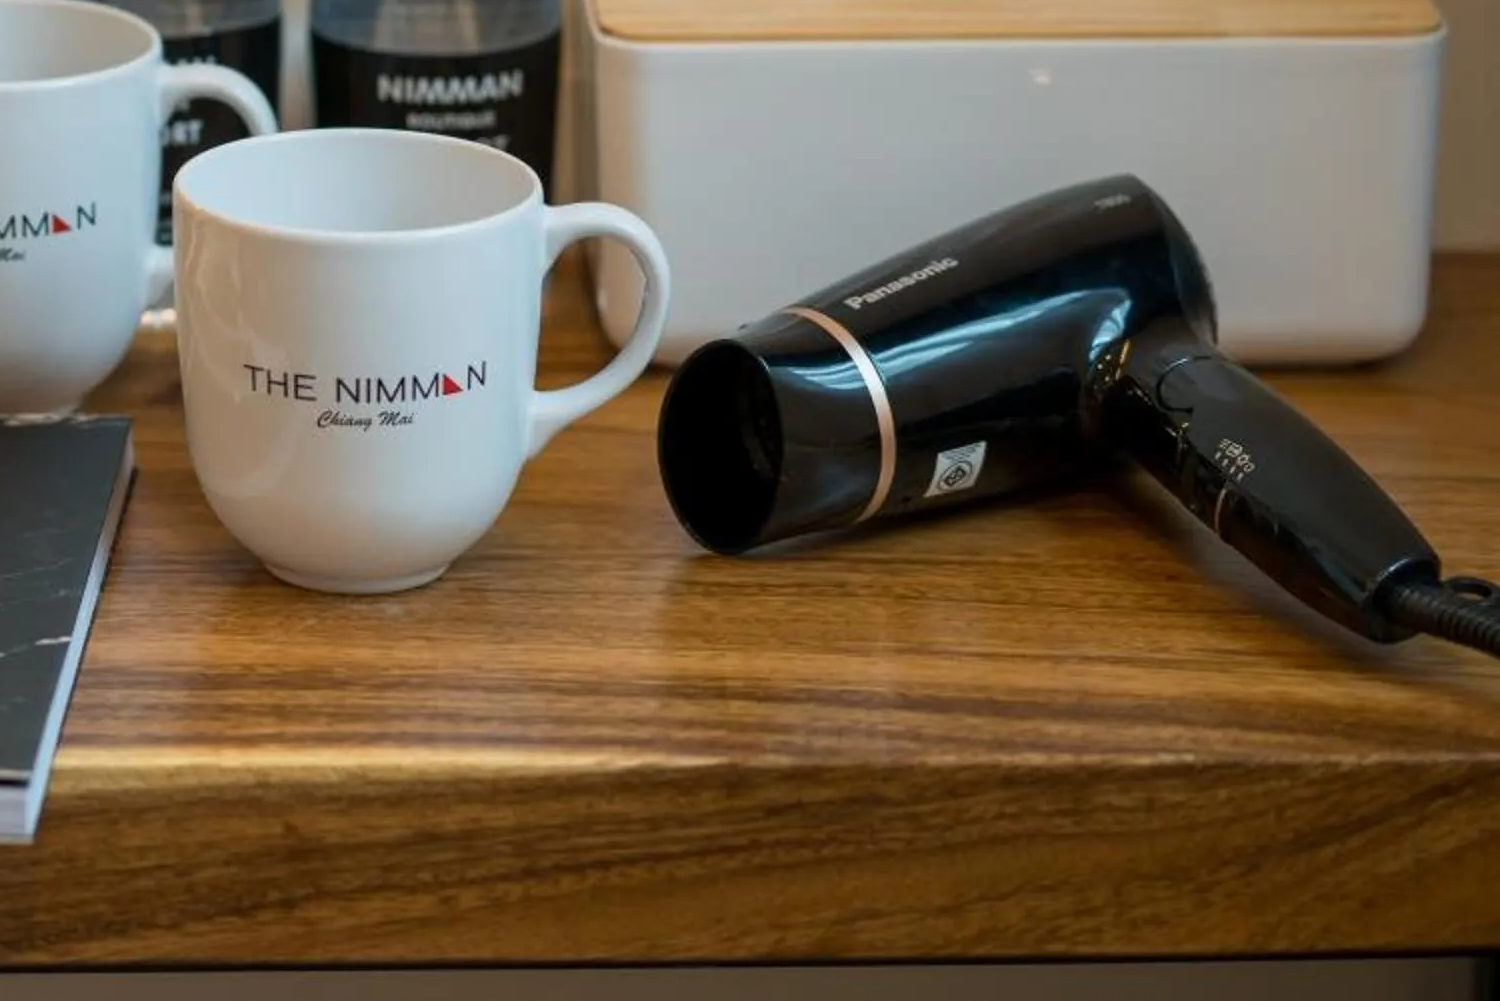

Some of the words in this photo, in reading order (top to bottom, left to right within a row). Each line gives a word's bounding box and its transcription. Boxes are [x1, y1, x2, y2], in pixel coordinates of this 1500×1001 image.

[376, 68, 525, 105] NIMMAN
[843, 257, 959, 311] Panasonic
[243, 363, 318, 402] THE
[316, 408, 373, 431] Chiang
[378, 410, 416, 426] Mai
